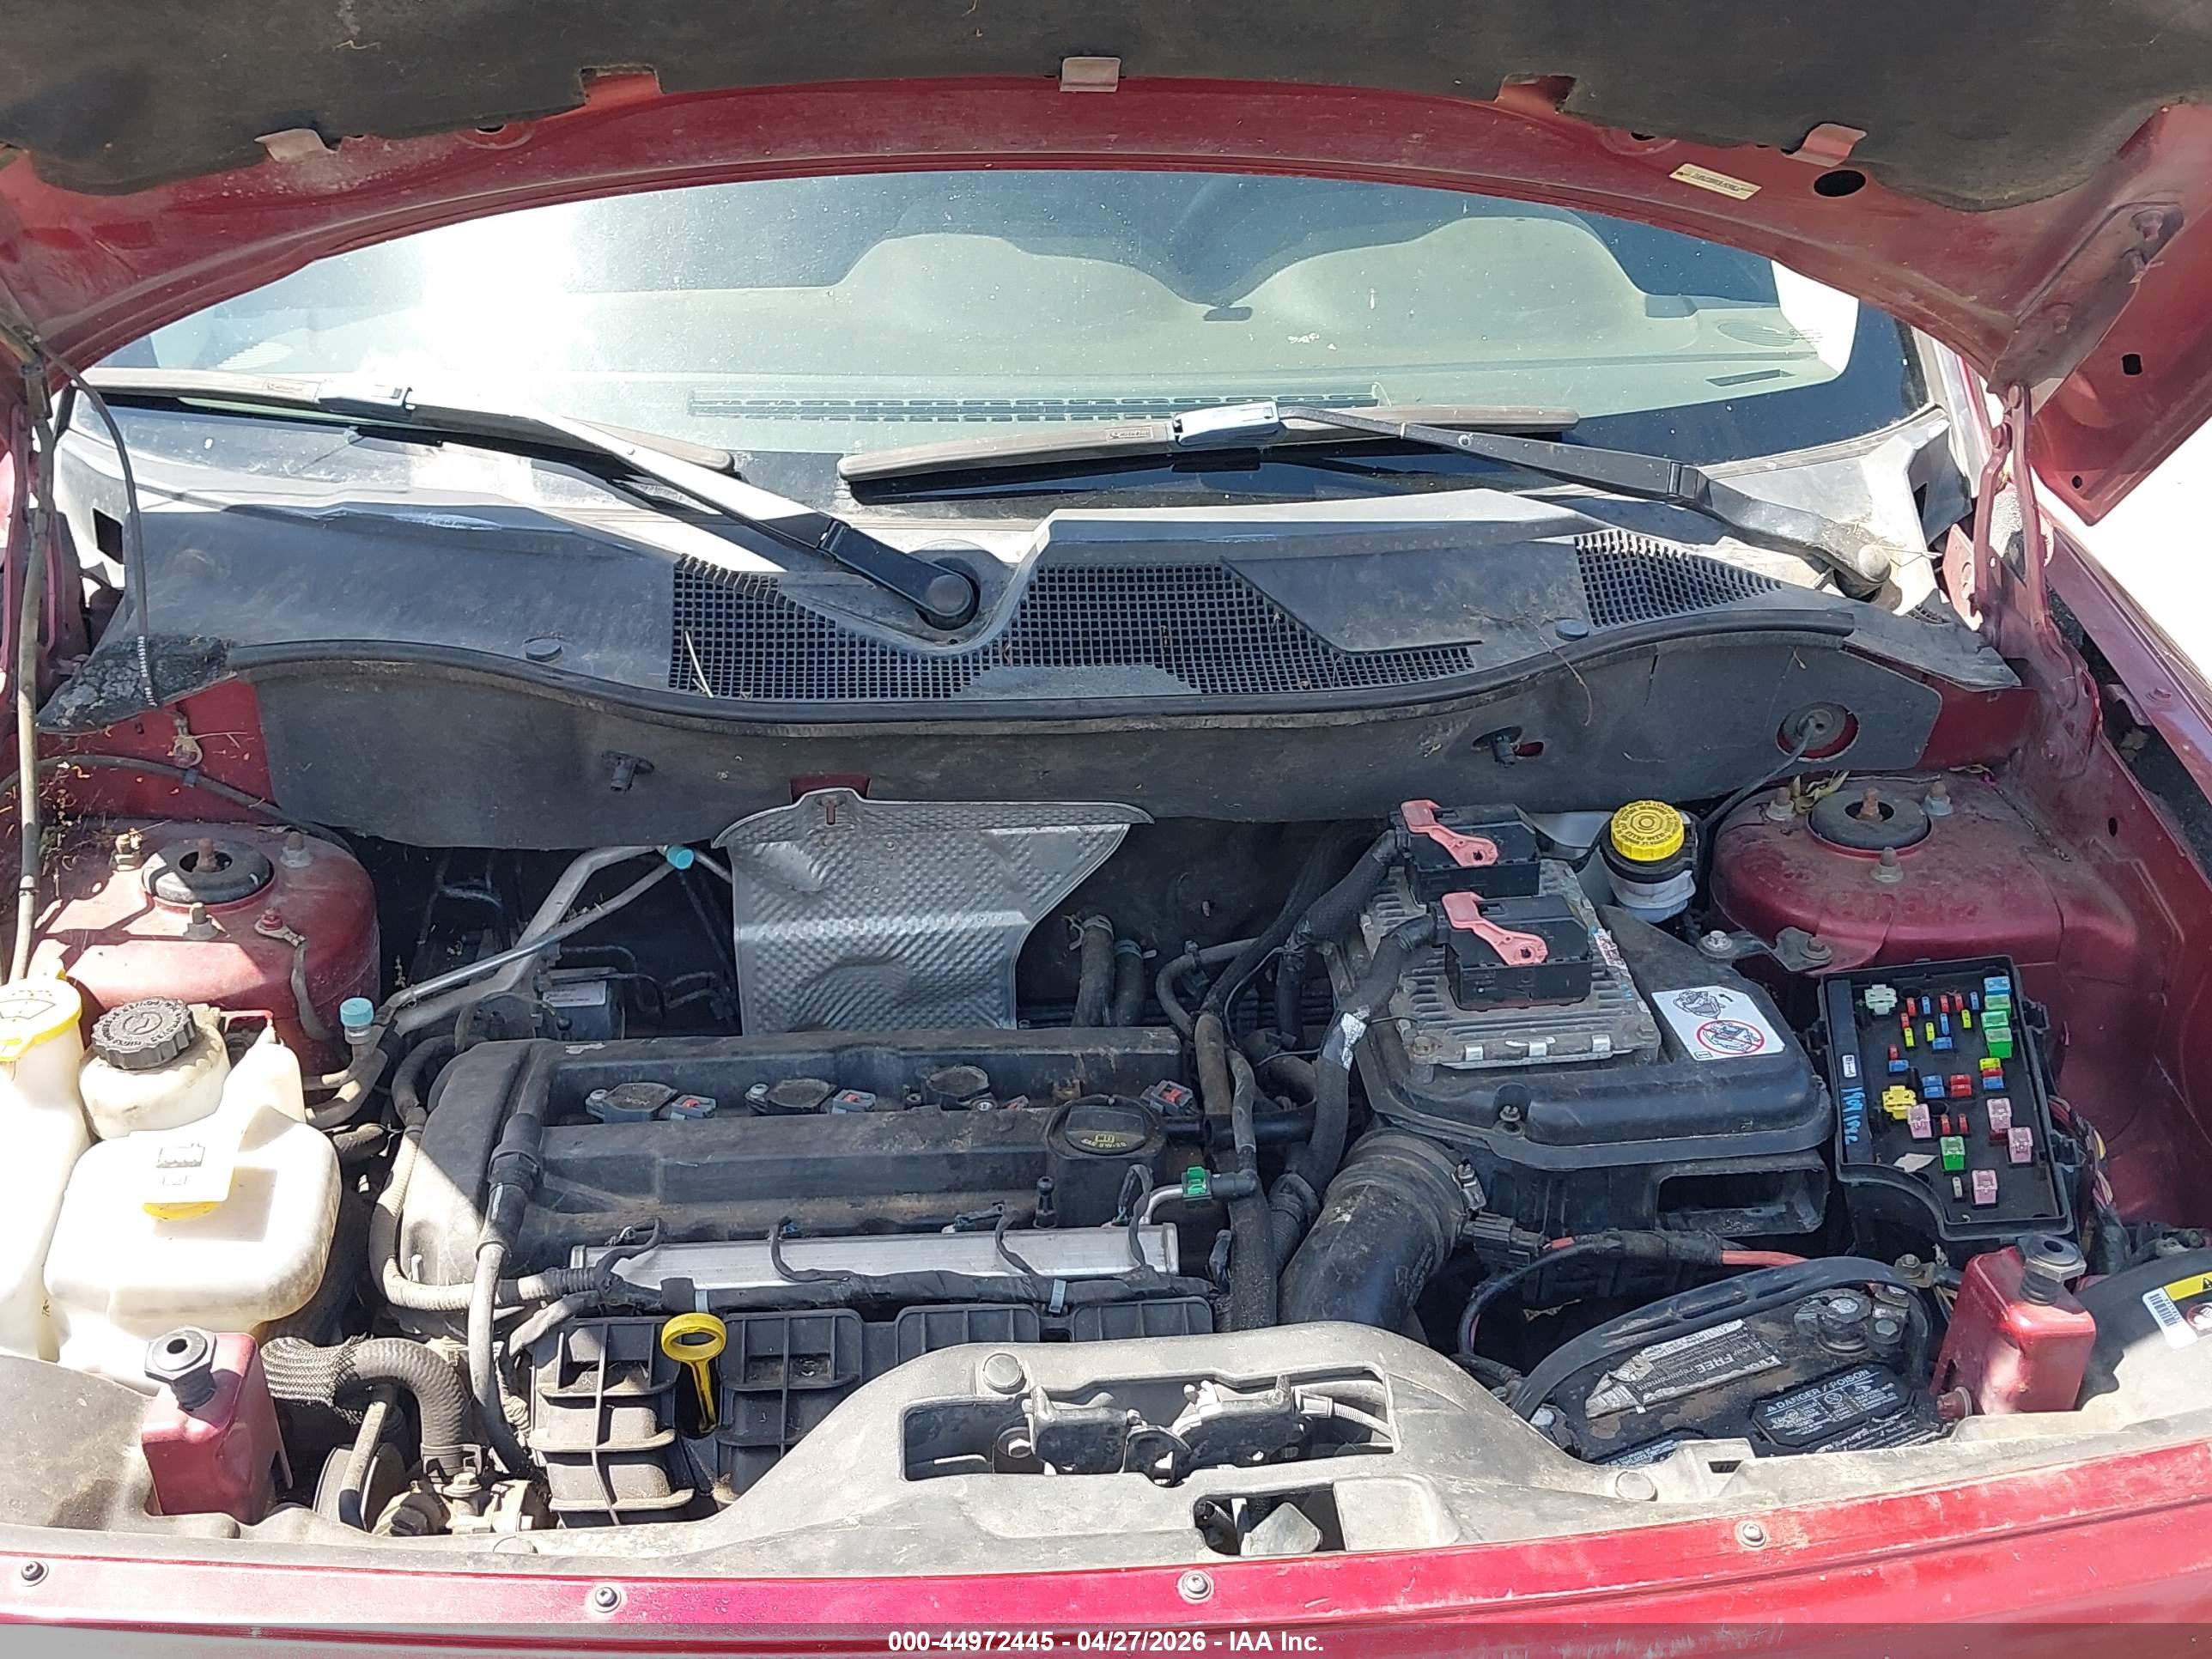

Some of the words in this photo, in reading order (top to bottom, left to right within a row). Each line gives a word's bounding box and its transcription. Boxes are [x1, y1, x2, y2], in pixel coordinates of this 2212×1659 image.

[1695, 1353, 1735, 1374] FREE
[1637, 1367, 1693, 1392] replacement
[1776, 1388, 1821, 1409] DANGER
[1828, 1369, 1870, 1389] POISON
